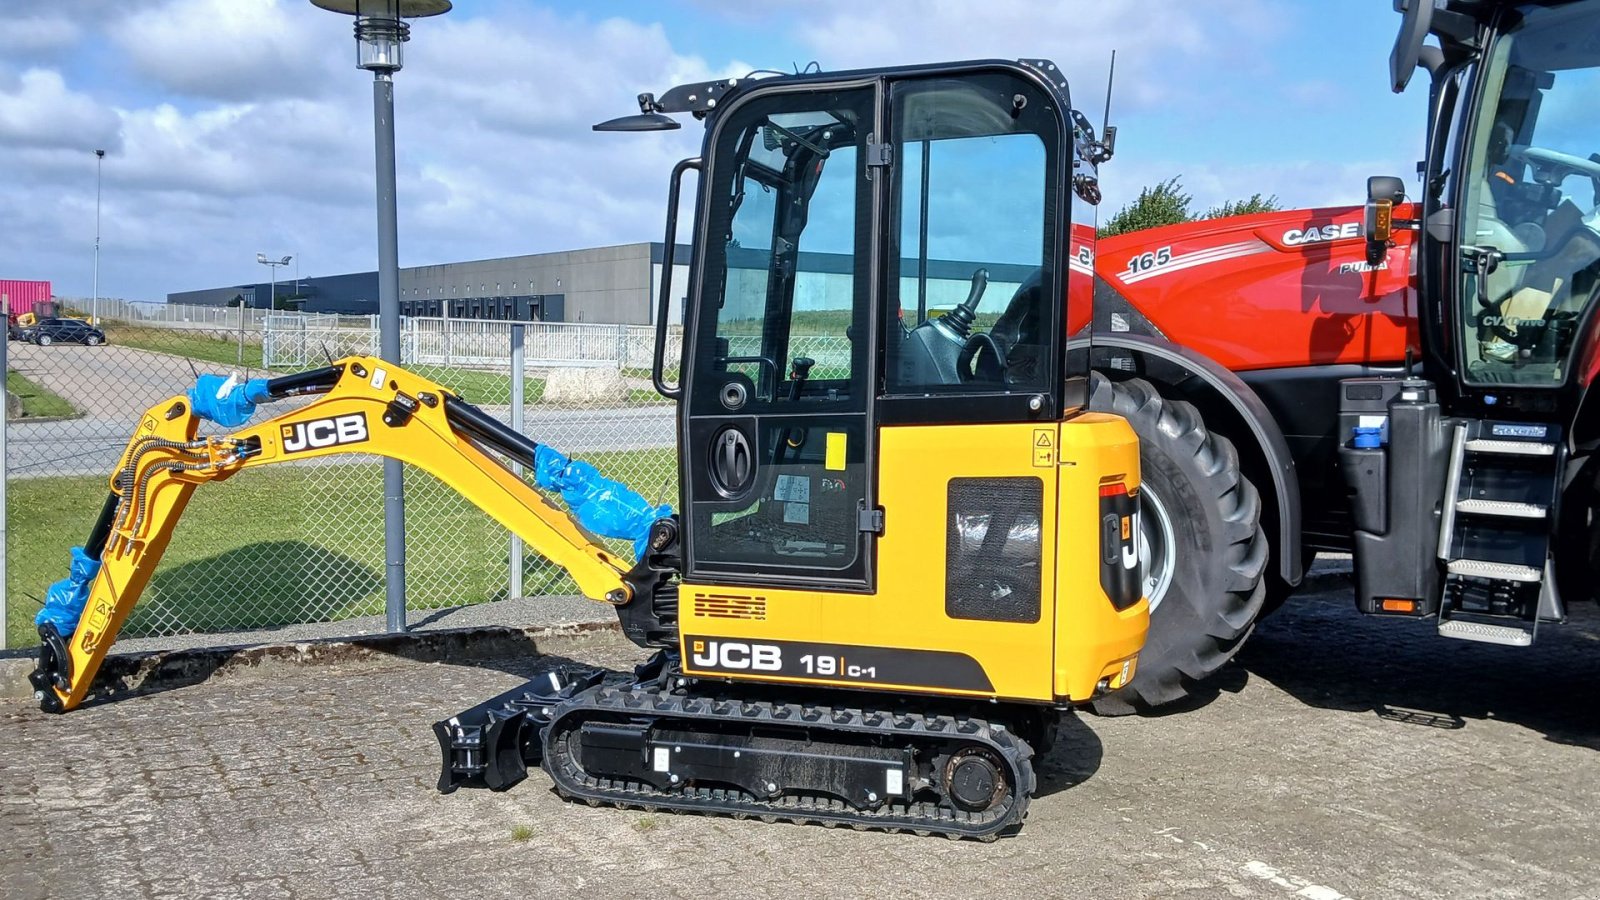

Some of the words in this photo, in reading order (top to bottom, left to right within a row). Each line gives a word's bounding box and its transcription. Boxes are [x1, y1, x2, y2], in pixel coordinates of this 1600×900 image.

[1282, 222, 1359, 246] CASE
[1127, 246, 1171, 274] 165
[1482, 316, 1547, 327] CVXDrive
[283, 415, 367, 451] JCB
[694, 641, 782, 671] JCB
